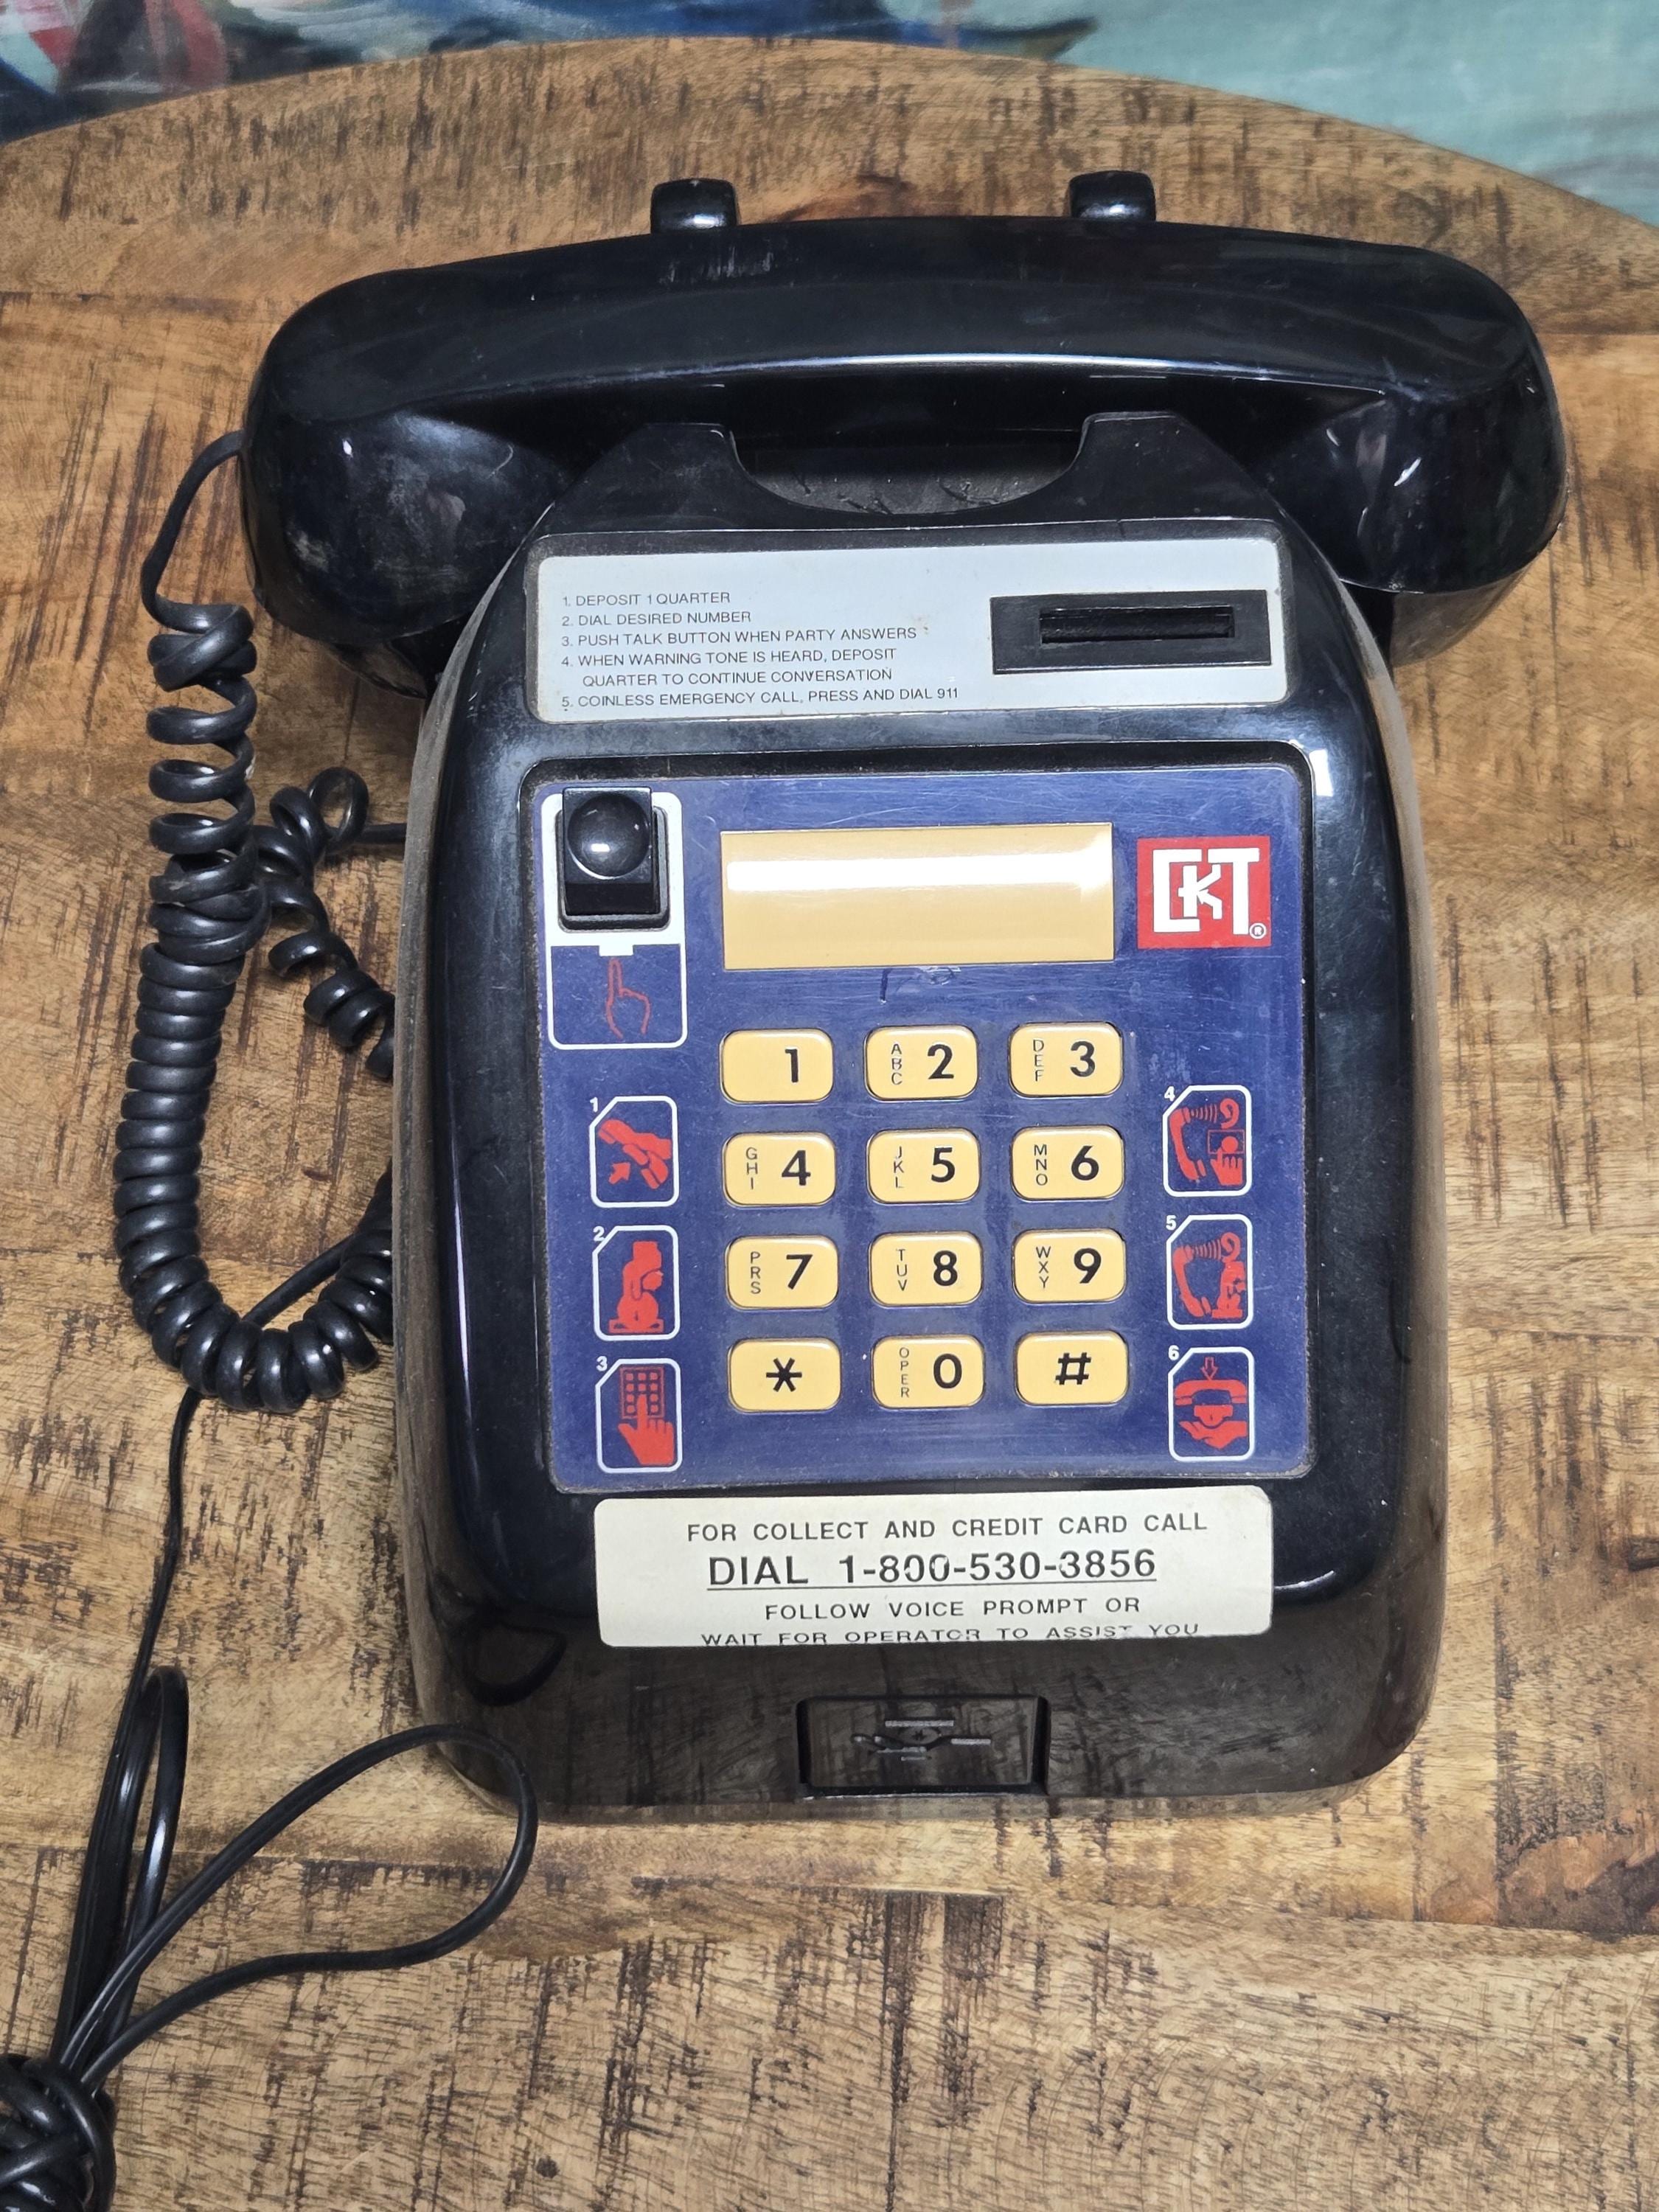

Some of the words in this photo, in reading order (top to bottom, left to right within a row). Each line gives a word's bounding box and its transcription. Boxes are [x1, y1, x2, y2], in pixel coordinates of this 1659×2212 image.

[563, 597, 571, 606] 1.
[577, 594, 641, 606] DEPOSIT
[647, 594, 652, 605] 1
[656, 592, 730, 605] QUARTER
[562, 616, 573, 626] 2.
[579, 614, 611, 626] DIAL
[617, 613, 682, 625] DESIRED
[687, 611, 751, 623] NUMBER
[562, 636, 573, 647] 3.
[579, 634, 619, 646] PUSH
[622, 633, 662, 645] TALK
[668, 631, 730, 644] BUTTON
[734, 630, 780, 643] WHEN
[786, 630, 835, 641] PARTY
[841, 627, 917, 640] ANSWERS
[561, 656, 573, 667] 4.
[578, 655, 624, 667] WHEN
[629, 653, 701, 665] WARNING
[705, 651, 748, 664] TONE
[754, 651, 765, 663] IS
[770, 650, 827, 663] HEARD,
[832, 648, 897, 661] DEPOSIT
[583, 674, 658, 686] QUARTER
[661, 673, 684, 685] TO
[689, 672, 766, 684] CONTINUE
[771, 669, 891, 683] CONVERSATION
[562, 697, 573, 707] 5.
[578, 695, 654, 707] COINLESS
[660, 692, 755, 705] EMERGENCY
[809, 690, 858, 702] PRESS
[863, 689, 894, 700] AND
[900, 688, 933, 700] DIAL
[937, 687, 957, 699] 911
[785, 1048, 799, 1083] 1
[927, 1044, 955, 1079] 2
[1069, 1040, 1096, 1077] 3
[590, 1097, 599, 1112] 1
[1164, 1086, 1175, 1102] 4
[781, 1150, 811, 1186] 4
[931, 1147, 956, 1183] 5
[1070, 1144, 1100, 1181] 6
[593, 1225, 605, 1242] 2
[1165, 1215, 1177, 1231] 5
[785, 1253, 814, 1290] 7
[933, 1250, 959, 1287] 8
[1073, 1247, 1102, 1284] 9
[596, 1356, 608, 1371] 3
[1168, 1345, 1180, 1360] 6
[933, 1352, 963, 1390] 0
[688, 1523, 736, 1542] FOR
[754, 1521, 869, 1540] COLLECT
[885, 1520, 935, 1539] AND
[953, 1517, 1043, 1537] CREDIT
[1059, 1516, 1127, 1534] CARD
[1144, 1512, 1207, 1531] CALL
[709, 1556, 808, 1585] DIAL
[839, 1549, 1155, 1584] 1-800-530-3856
[765, 1603, 870, 1620] FOLLOW
[888, 1601, 964, 1618] VOICE
[984, 1599, 1088, 1615] PROMPT
[1105, 1597, 1139, 1612] OR
[702, 1633, 762, 1646] WAIT
[779, 1632, 827, 1644] FOR
[997, 1628, 1028, 1640] TO
[1149, 1624, 1198, 1635] YOU
